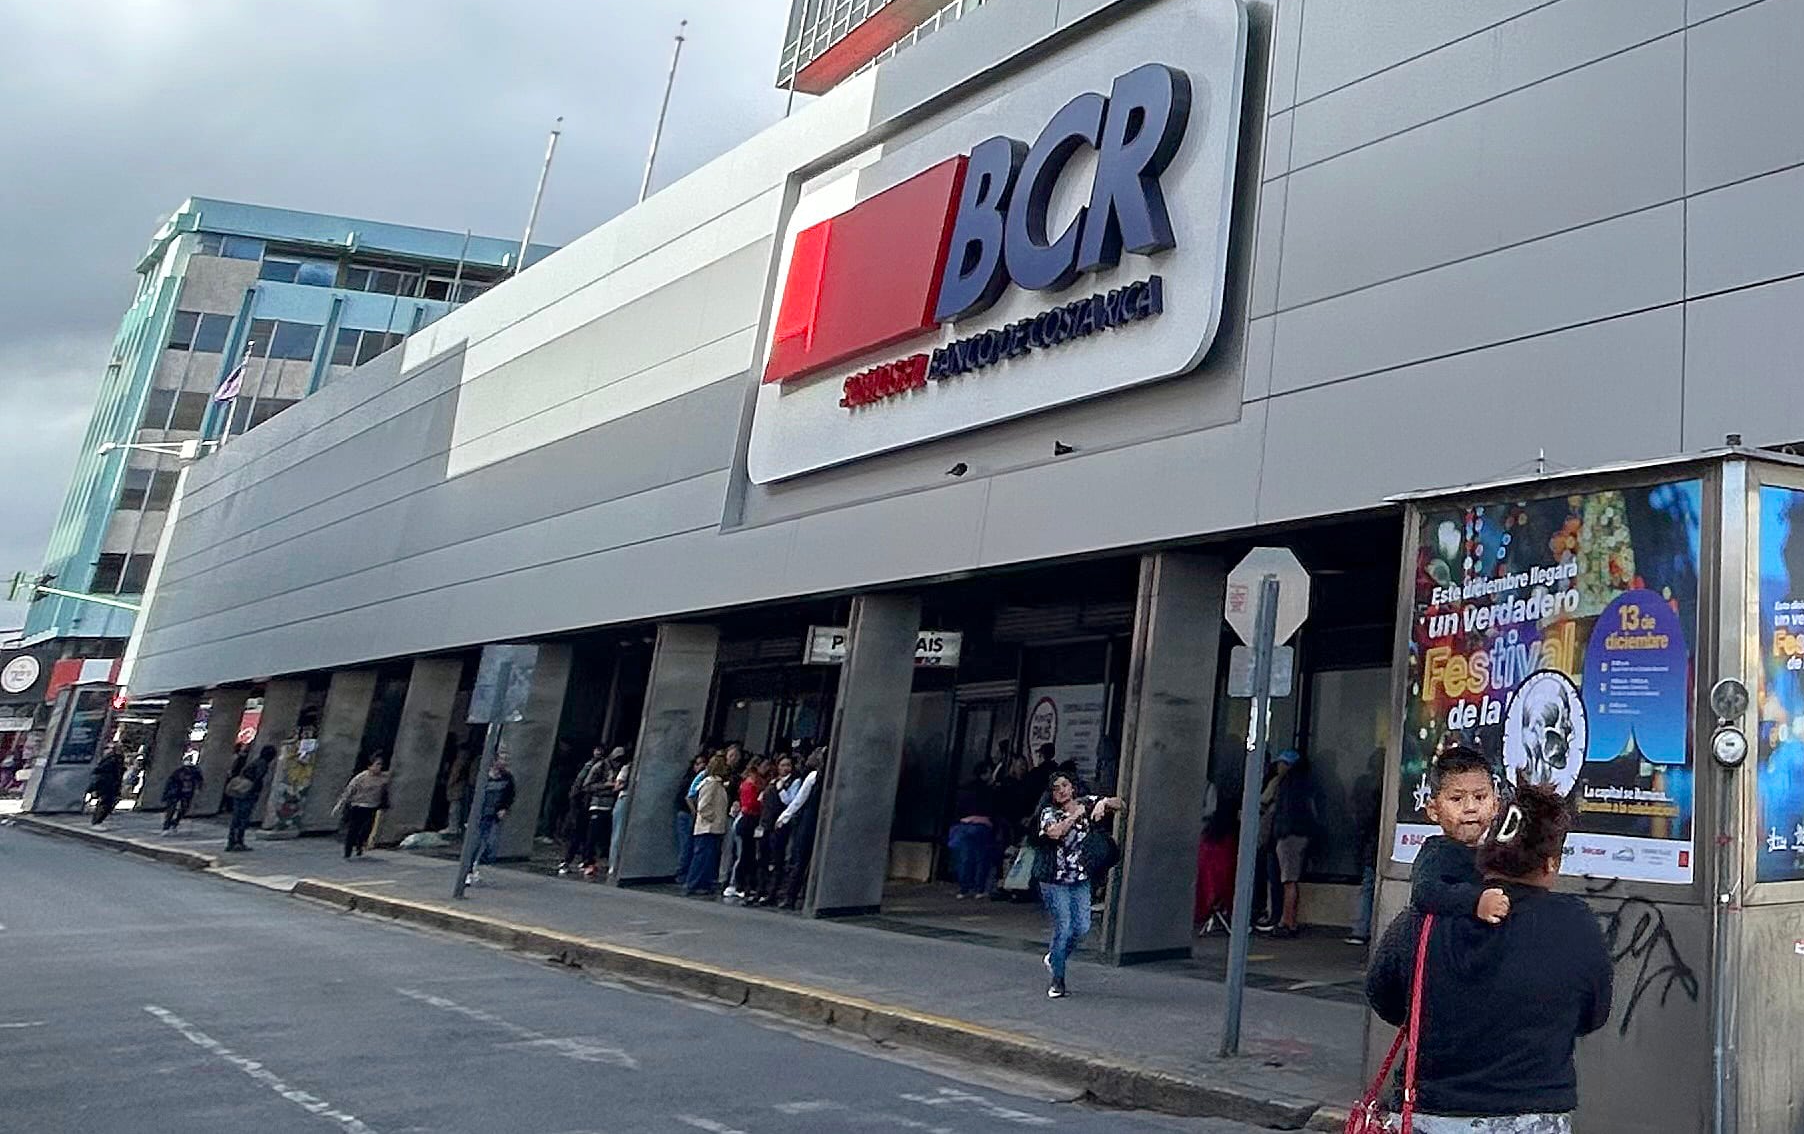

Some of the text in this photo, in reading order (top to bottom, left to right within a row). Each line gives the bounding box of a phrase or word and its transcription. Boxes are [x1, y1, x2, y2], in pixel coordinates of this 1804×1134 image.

[934, 63, 1191, 323] BCR
[1104, 274, 1163, 328] RICA
[1432, 585, 1461, 606] Este
[1463, 573, 1528, 599] diciembre
[1428, 589, 1579, 638] un verdadero
[1619, 605, 1656, 631] 13 de
[1774, 614, 1789, 626] un
[1605, 631, 1669, 650] diciembre
[1422, 621, 1576, 701] Festival
[1787, 656, 1802, 670] de
[1448, 699, 1477, 730] de
[1479, 696, 1500, 726] la
